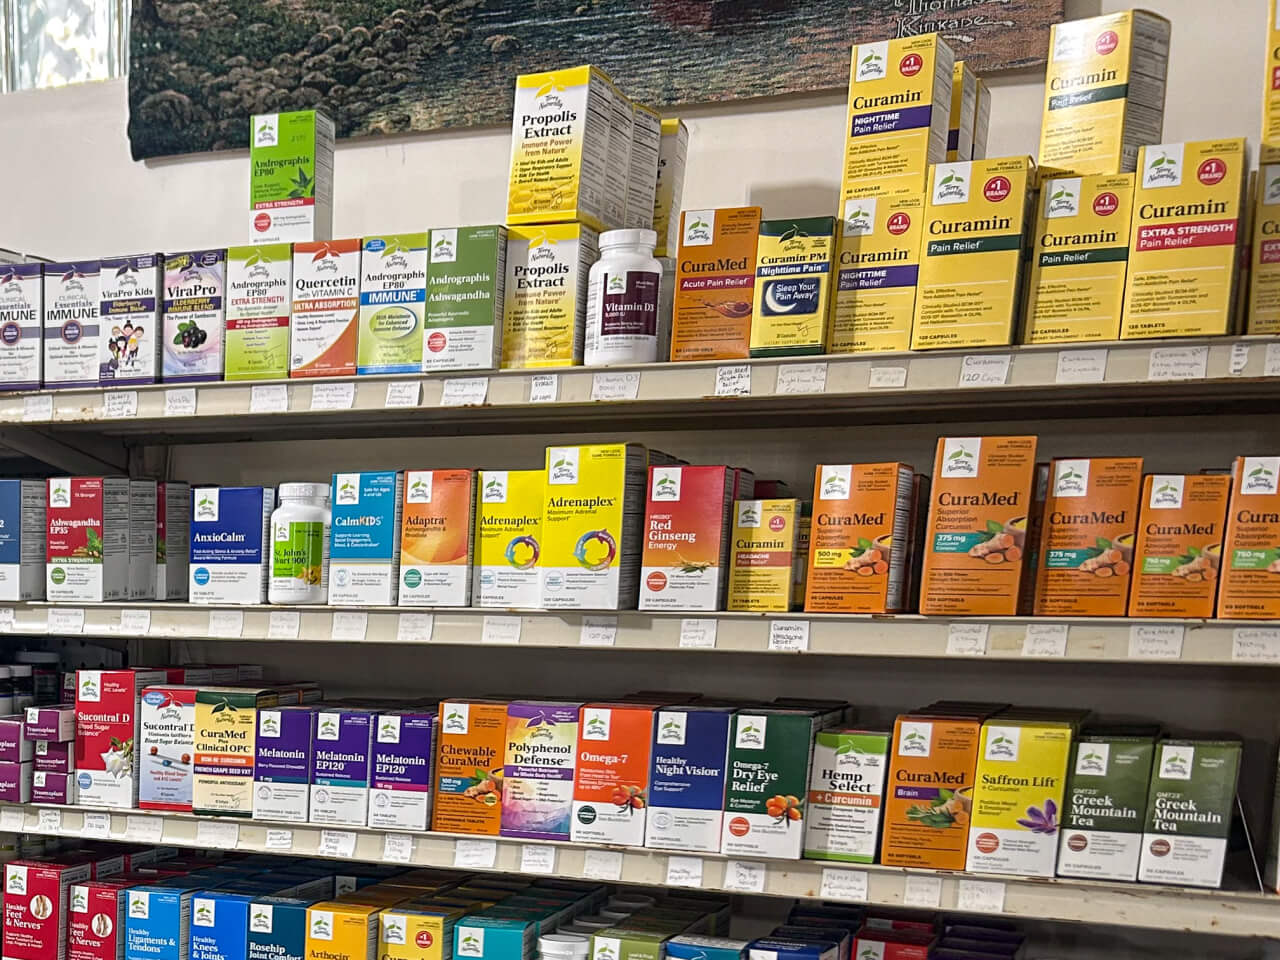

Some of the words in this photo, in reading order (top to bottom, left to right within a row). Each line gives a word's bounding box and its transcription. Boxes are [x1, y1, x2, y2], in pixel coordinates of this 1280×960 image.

[853, 89, 920, 110] Curamin
[522, 111, 577, 126] Propolis
[854, 112, 899, 126] NIGHTTIME
[524, 125, 571, 138] Extract
[854, 125, 871, 134] Pain
[873, 122, 896, 132] Relief
[1139, 201, 1227, 220] Curamin
[930, 217, 1010, 235] Curamin
[1141, 225, 1174, 238] EXTRA
[1178, 222, 1233, 235] STRENGTH
[1041, 230, 1116, 248] Curamin
[1141, 238, 1159, 248] Pain
[1161, 236, 1194, 246] Relief
[931, 242, 951, 252] Pain
[954, 241, 982, 251] Relief
[761, 255, 807, 264] Curamin
[809, 253, 826, 261] PM
[1042, 254, 1060, 264] Pain
[1062, 252, 1090, 262] Relief
[514, 264, 569, 278] Propolis
[682, 258, 747, 273] CuraMed
[761, 266, 800, 275] Nighttime
[803, 265, 822, 273] Pain
[365, 271, 424, 282] Andrographis
[517, 277, 564, 288] Extract
[231, 279, 286, 290] Andrographis
[296, 277, 356, 289] Quercetin
[683, 280, 704, 289] Acute
[707, 279, 722, 287] Pain
[724, 278, 748, 286] Relief
[776, 284, 796, 293] Sleep
[798, 282, 815, 291] Your
[102, 289, 132, 298] ViraPro
[135, 288, 153, 296] Kids
[167, 283, 216, 296] ViraPro
[429, 289, 490, 302] Ashwagandha
[369, 291, 417, 303] IMMUNE
[776, 292, 792, 300] Pain
[793, 291, 815, 301] Away
[605, 303, 642, 312] Vitamin
[644, 302, 654, 312] D3
[47, 309, 98, 320] IMMUNE
[962, 373, 978, 383] 120
[548, 496, 613, 508] Adrenaplex
[938, 491, 1017, 507] CuraMed
[50, 519, 100, 528] Ashwagandha
[818, 513, 884, 527] CuraMed
[1050, 511, 1124, 524] CuraMed
[650, 520, 671, 531] Red
[1146, 523, 1215, 536] CuraMed
[194, 532, 244, 542] AnxioCalm
[649, 531, 695, 543] Ginseng
[649, 541, 677, 551] Energy
[736, 539, 783, 549] Curamin
[200, 729, 246, 739] CuraMed
[196, 743, 228, 753] Clinical
[231, 745, 248, 753] OPC
[441, 745, 496, 757] Chewable
[509, 742, 570, 756] Polyphenol
[317, 752, 364, 762] Melatonin
[581, 752, 628, 765] Omega-7
[656, 756, 687, 766] Healthy
[656, 765, 681, 777] Night
[684, 766, 717, 776] Vision
[822, 769, 862, 783] Hemp
[896, 770, 964, 785] CuraMed
[982, 774, 1028, 787] Saffron
[1033, 776, 1055, 788] Lift
[829, 780, 871, 793] Select
[898, 788, 918, 797] Brain
[1073, 794, 1112, 807] Greek
[1072, 805, 1136, 819] Mountain
[1155, 809, 1221, 824] Mountain
[1072, 816, 1094, 826] Tea
[6, 910, 22, 919] Feet
[128, 935, 166, 945] Ligaments
[169, 937, 175, 945] &
[193, 935, 215, 945] Healthy
[193, 943, 218, 953] Knees
[250, 942, 285, 955] Rosehip
[193, 951, 199, 959] &
[249, 951, 266, 960] Joint
